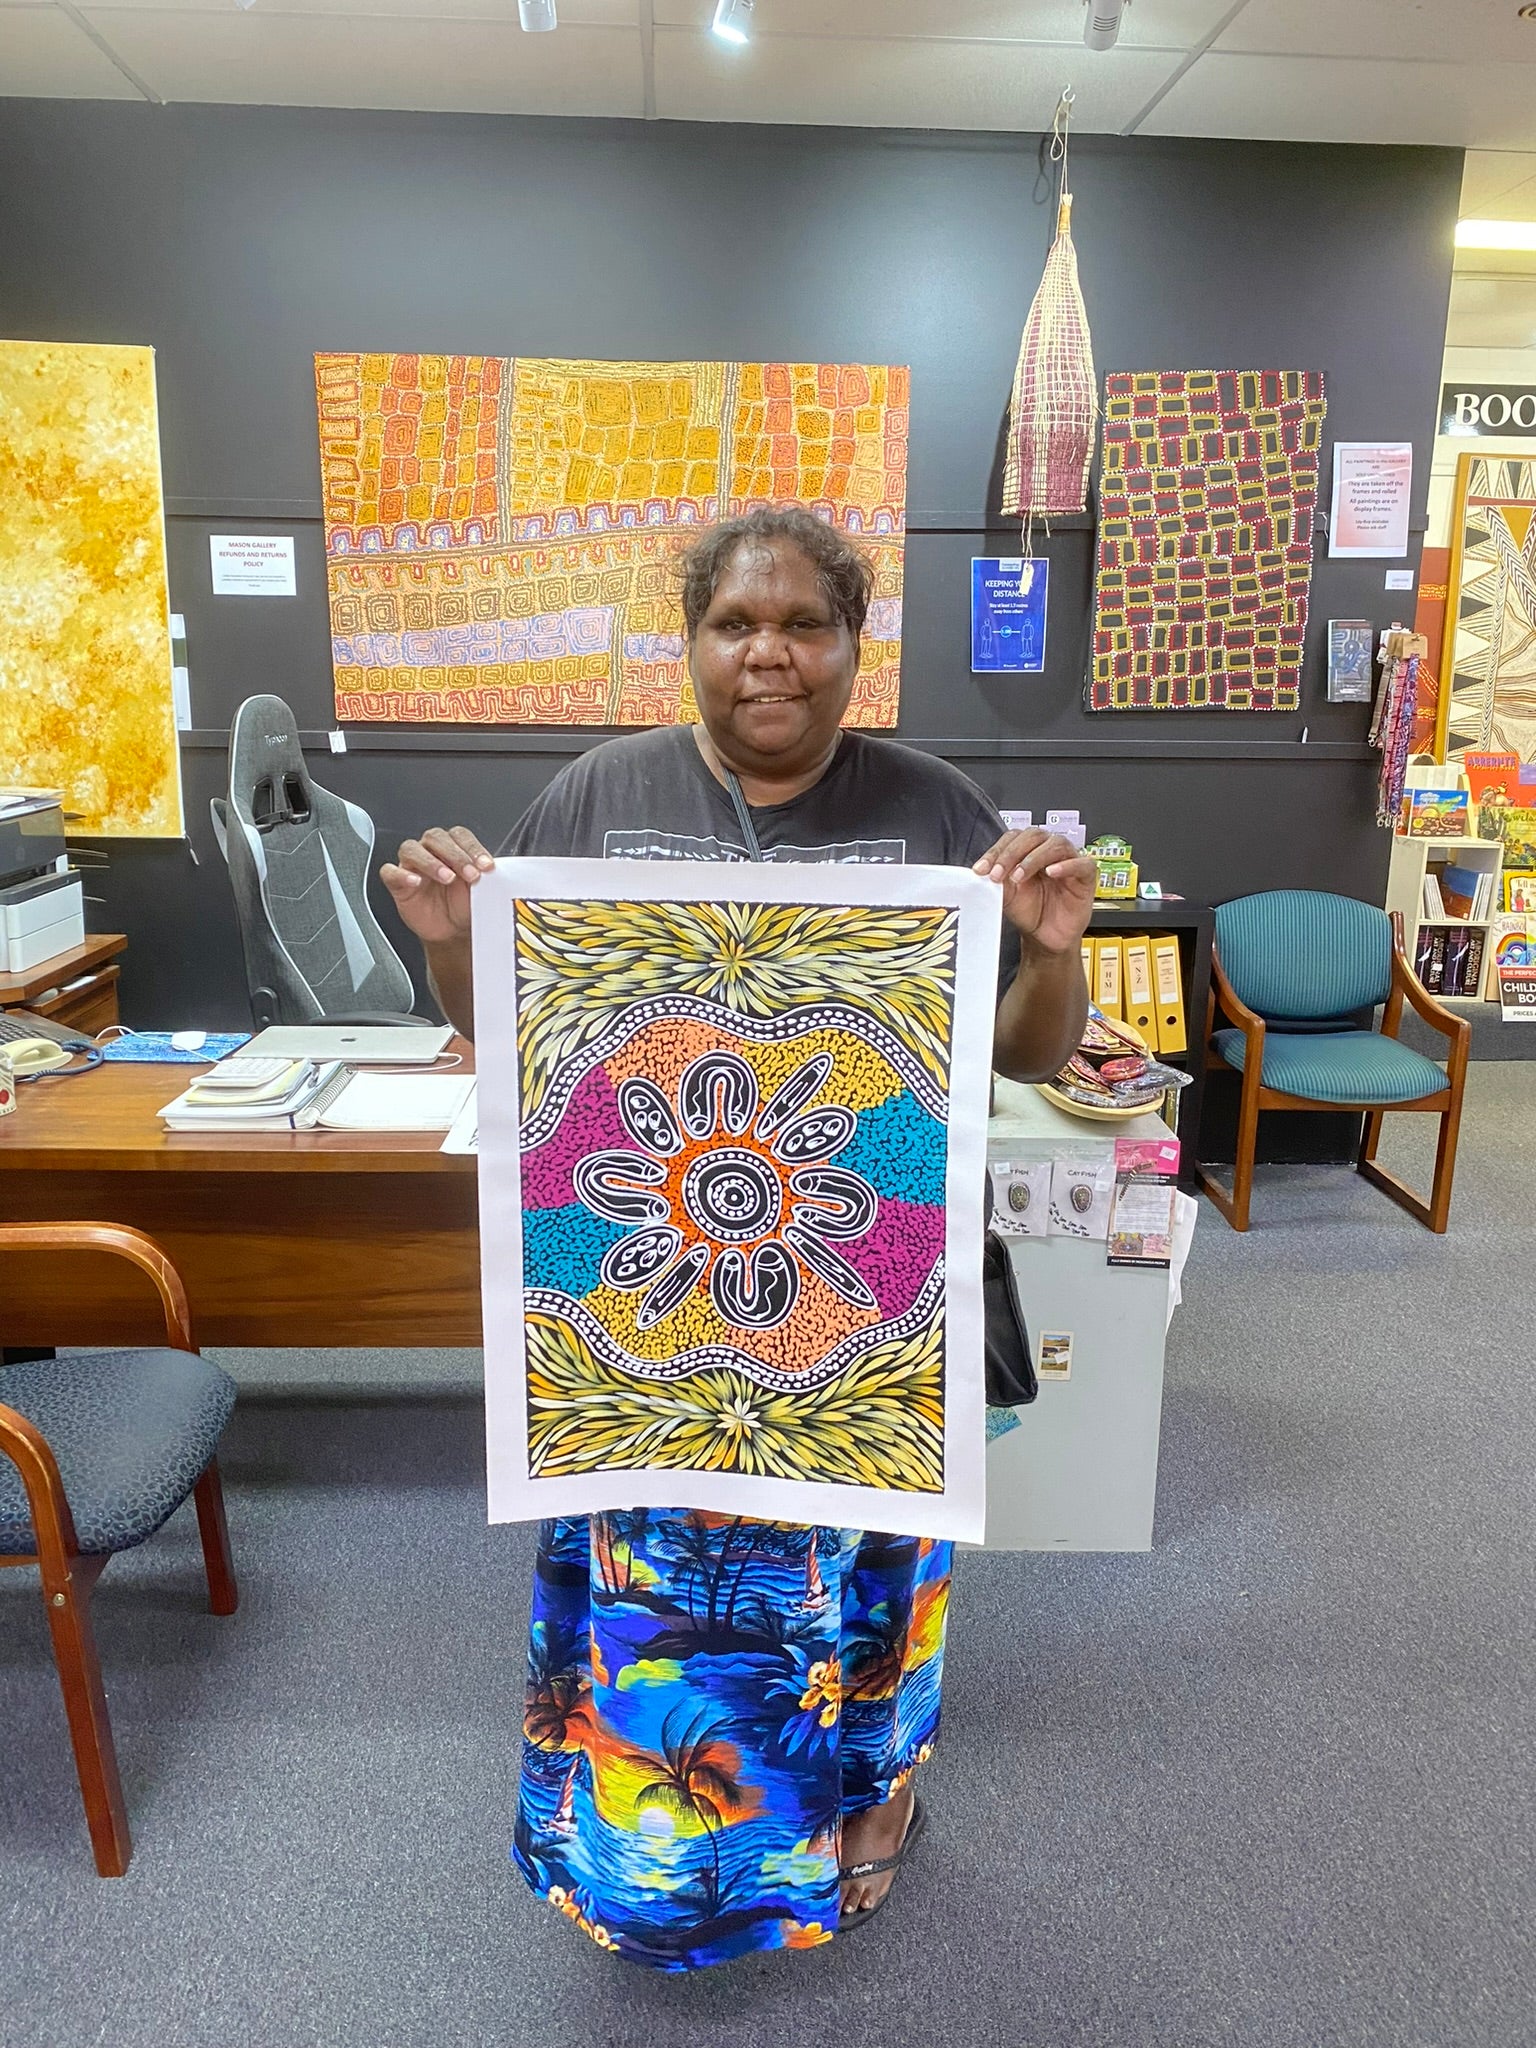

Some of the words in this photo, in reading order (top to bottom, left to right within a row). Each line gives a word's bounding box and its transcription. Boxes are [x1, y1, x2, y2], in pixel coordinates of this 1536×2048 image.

[1453, 393, 1536, 428] BOO
[985, 579, 1014, 588] KEEPING
[1518, 993, 1536, 1003] BO
[1010, 1168, 1029, 1176] TFISH
